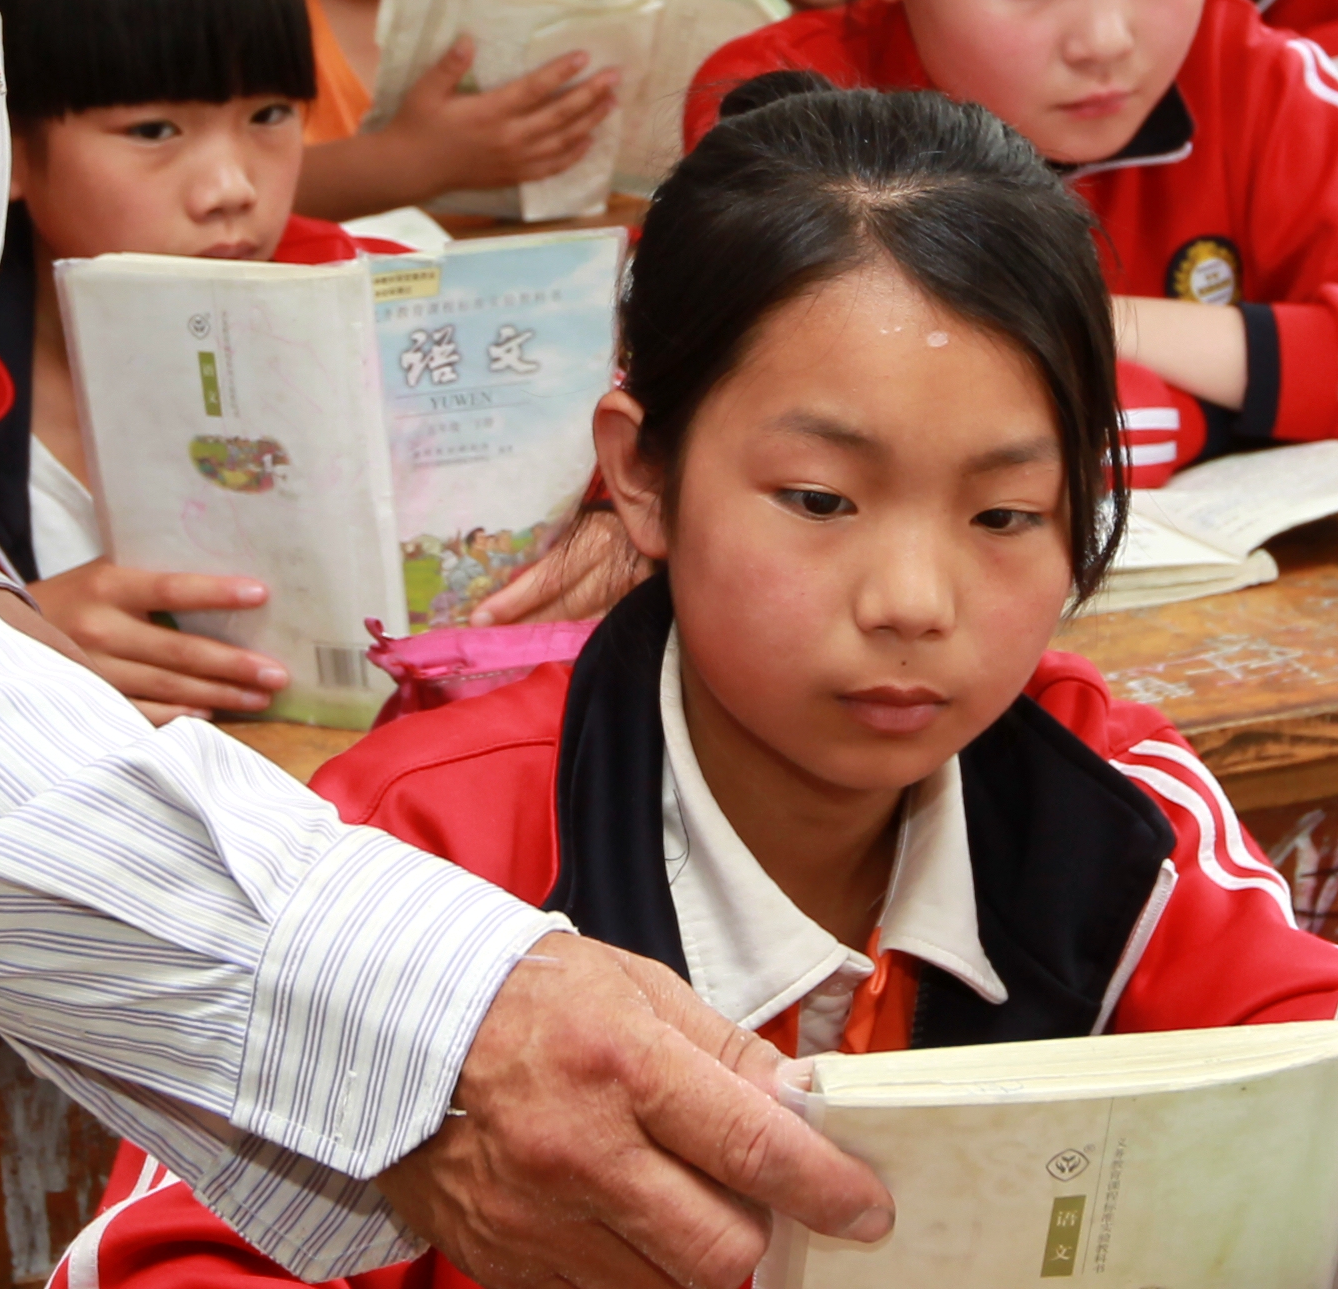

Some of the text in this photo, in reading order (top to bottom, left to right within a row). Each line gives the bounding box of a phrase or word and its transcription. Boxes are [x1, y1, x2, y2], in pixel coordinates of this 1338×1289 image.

[399, 322, 543, 389] 语文
[429, 391, 493, 410] YUWEN
[1050, 1209, 1079, 1262] 语文
